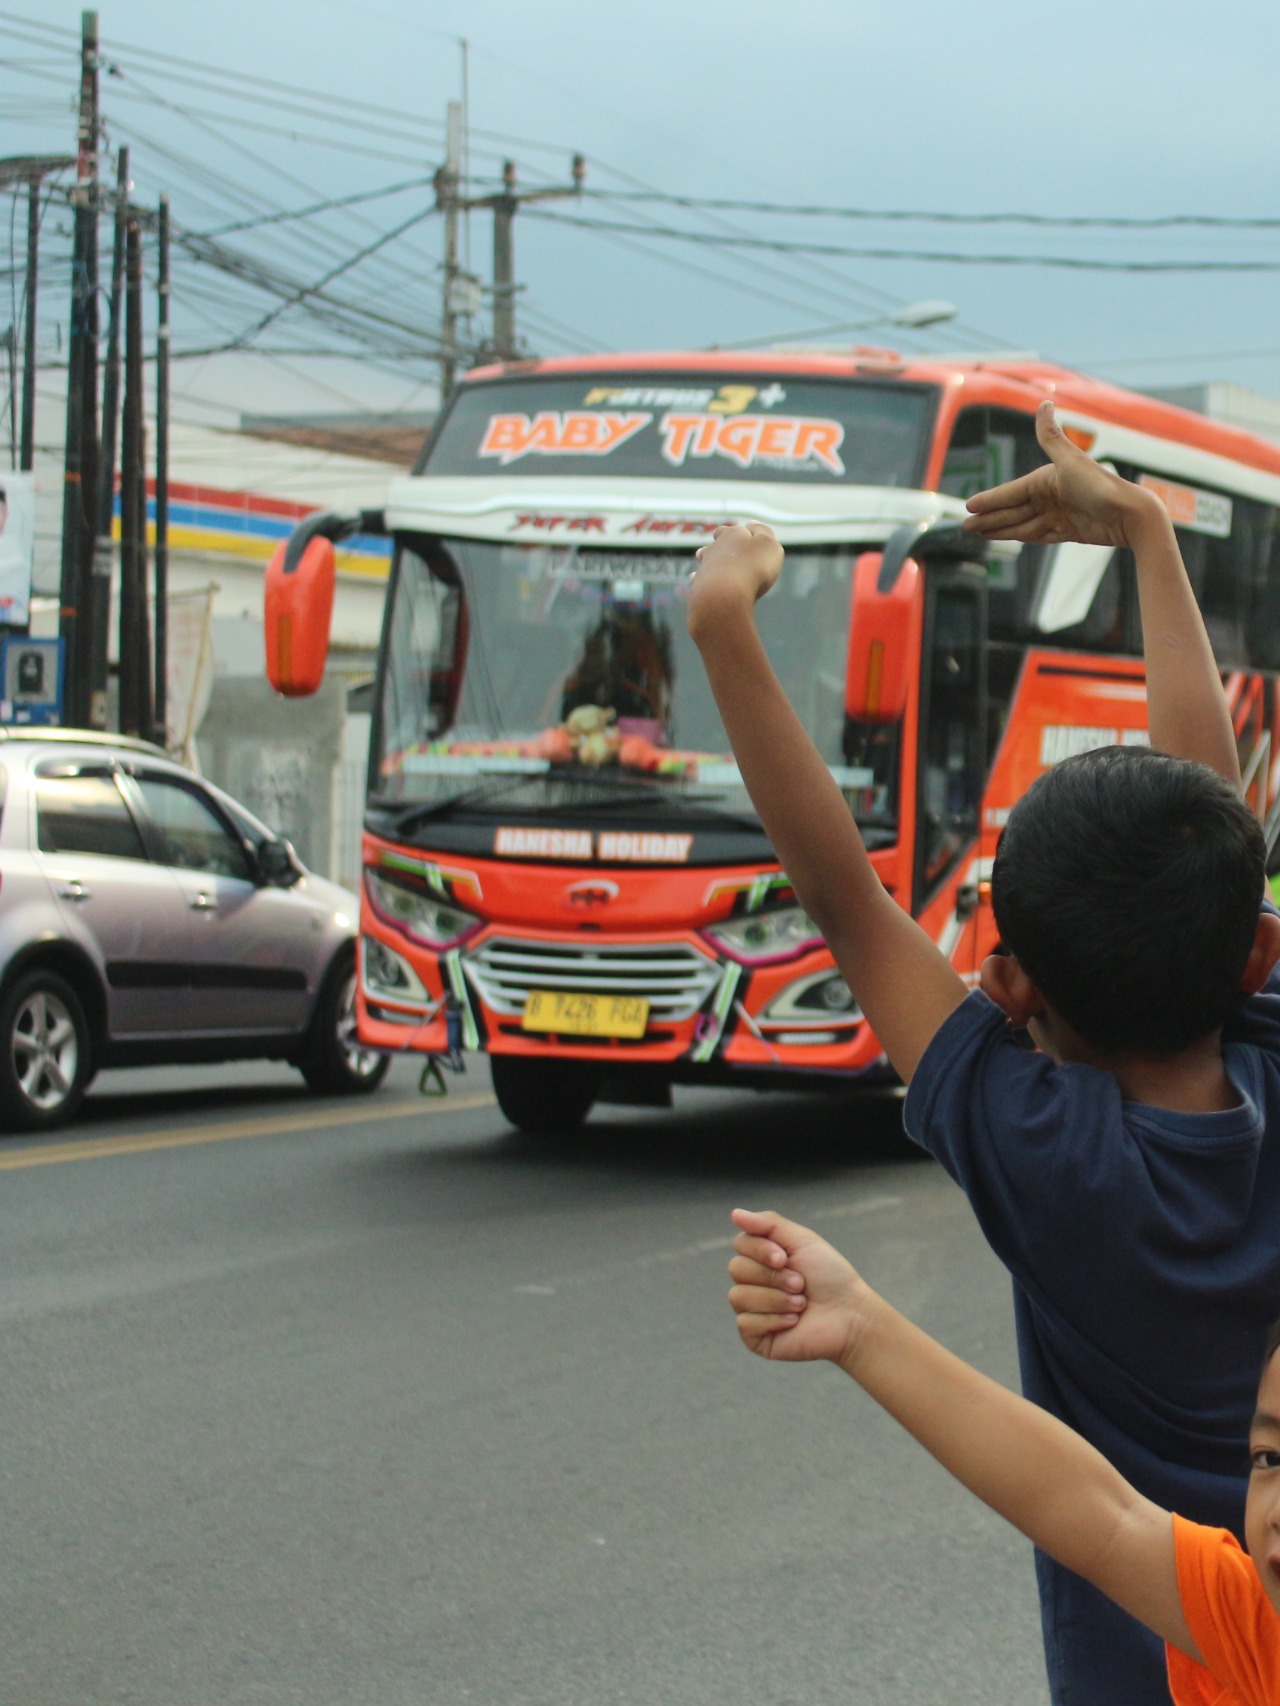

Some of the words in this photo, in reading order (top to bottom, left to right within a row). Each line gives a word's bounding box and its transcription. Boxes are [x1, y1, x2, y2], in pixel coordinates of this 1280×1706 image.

[479, 411, 653, 465] BABY
[659, 413, 845, 476] TIGER
[598, 831, 694, 863] HOLIDAY
